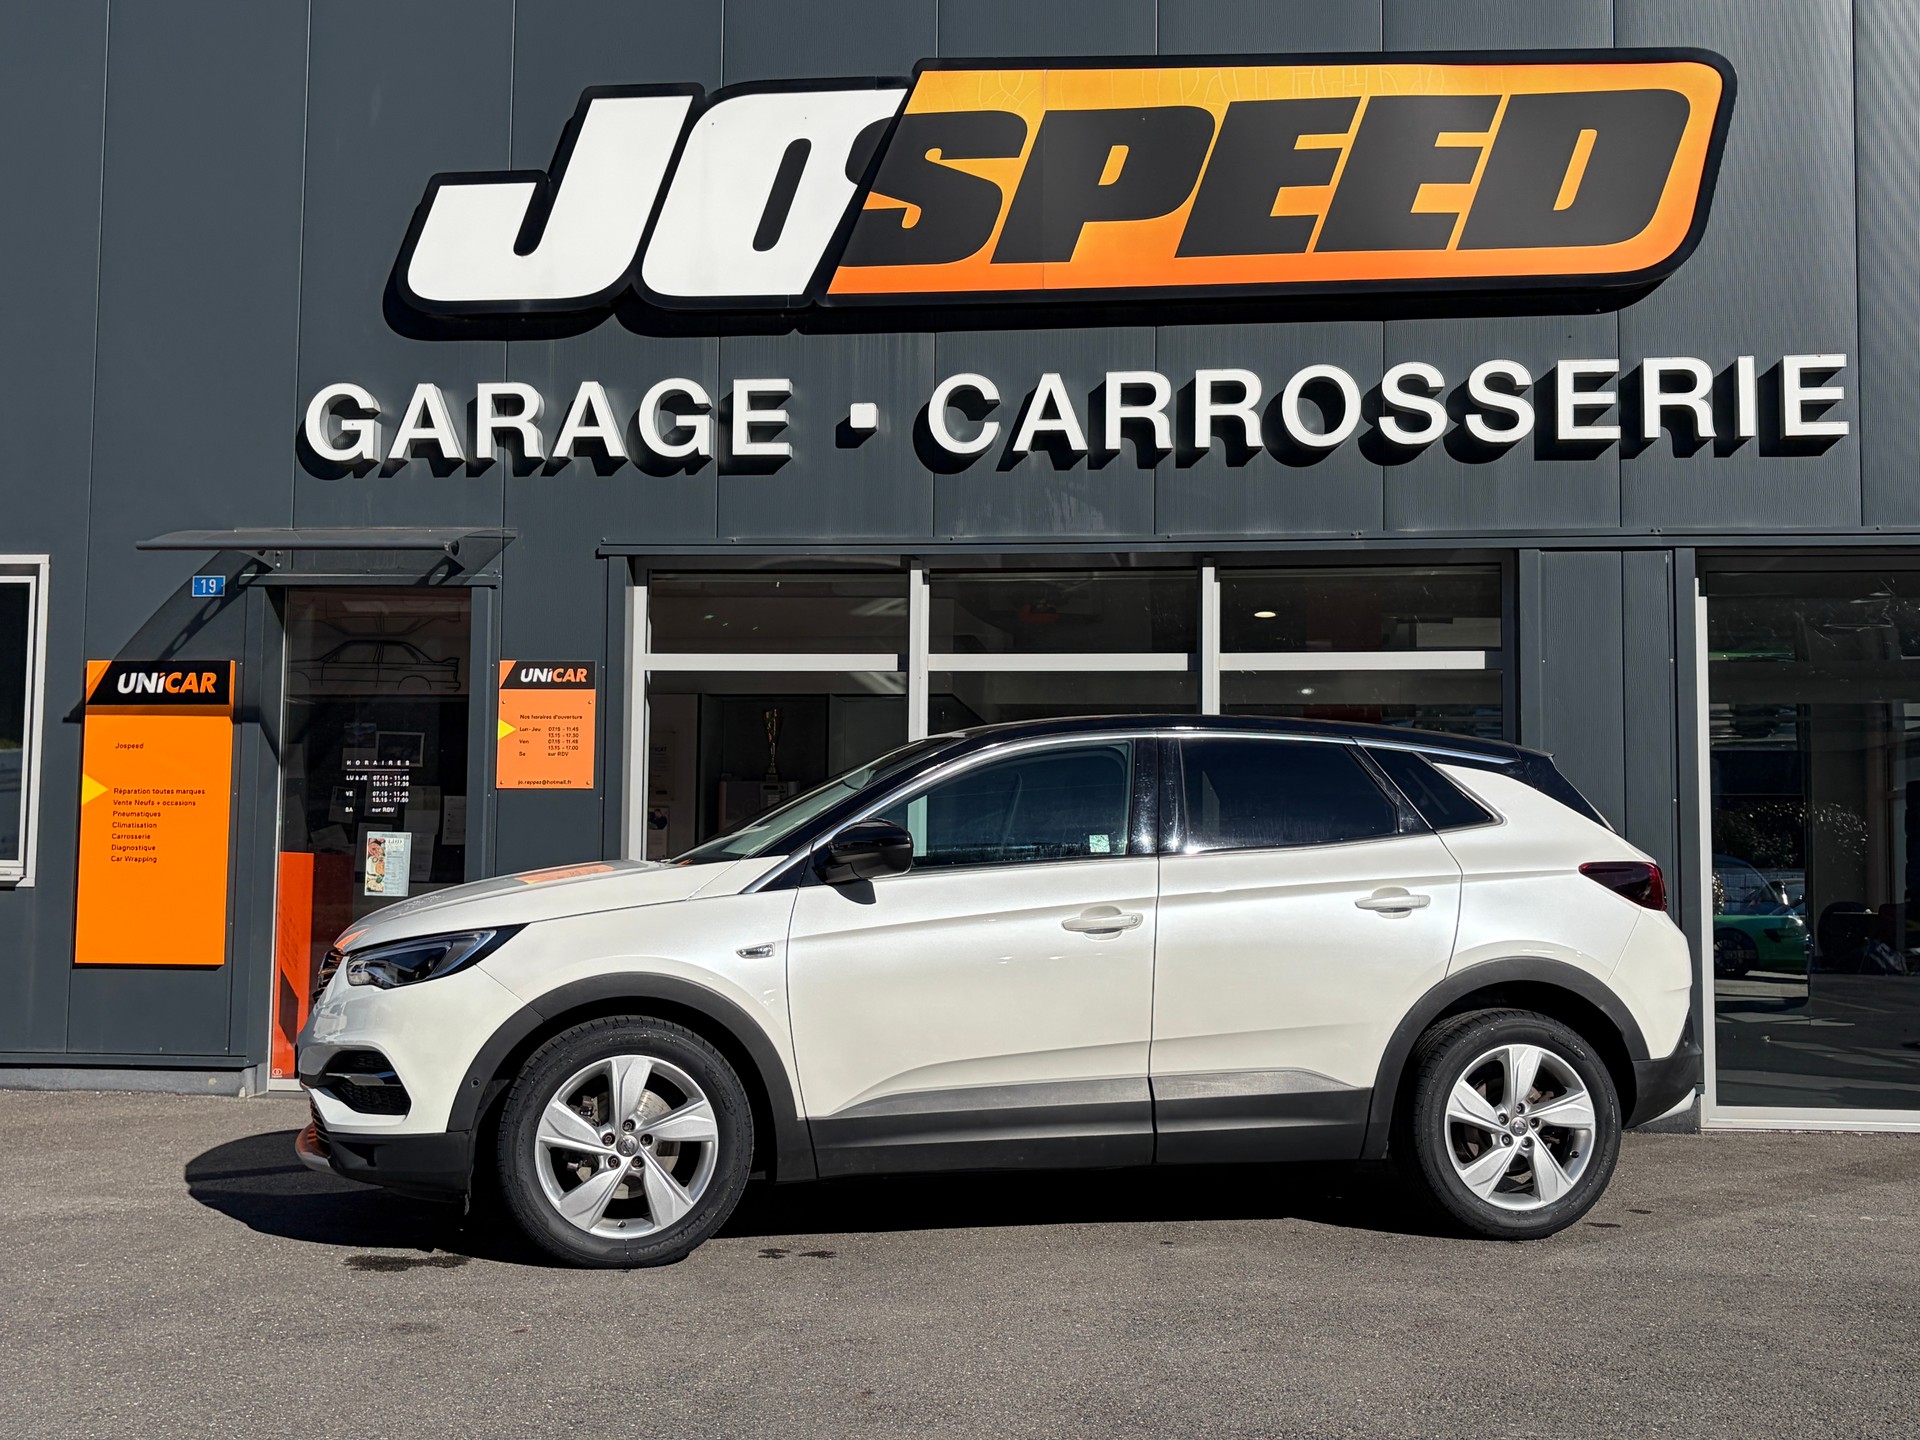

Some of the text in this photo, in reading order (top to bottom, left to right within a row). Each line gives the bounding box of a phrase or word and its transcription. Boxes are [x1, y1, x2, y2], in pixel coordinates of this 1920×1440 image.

[407, 88, 1692, 301] JOSPEED
[303, 353, 1850, 463] GARAGE CARROSSERIE
[200, 579, 217, 594] 19
[115, 742, 144, 750] Jospeed
[113, 787, 151, 795] Réparation
[112, 810, 162, 818] Pneumatiques
[111, 821, 158, 829] Climatisation
[111, 843, 156, 852] Diagnostique
[124, 855, 158, 863] Wrapping
